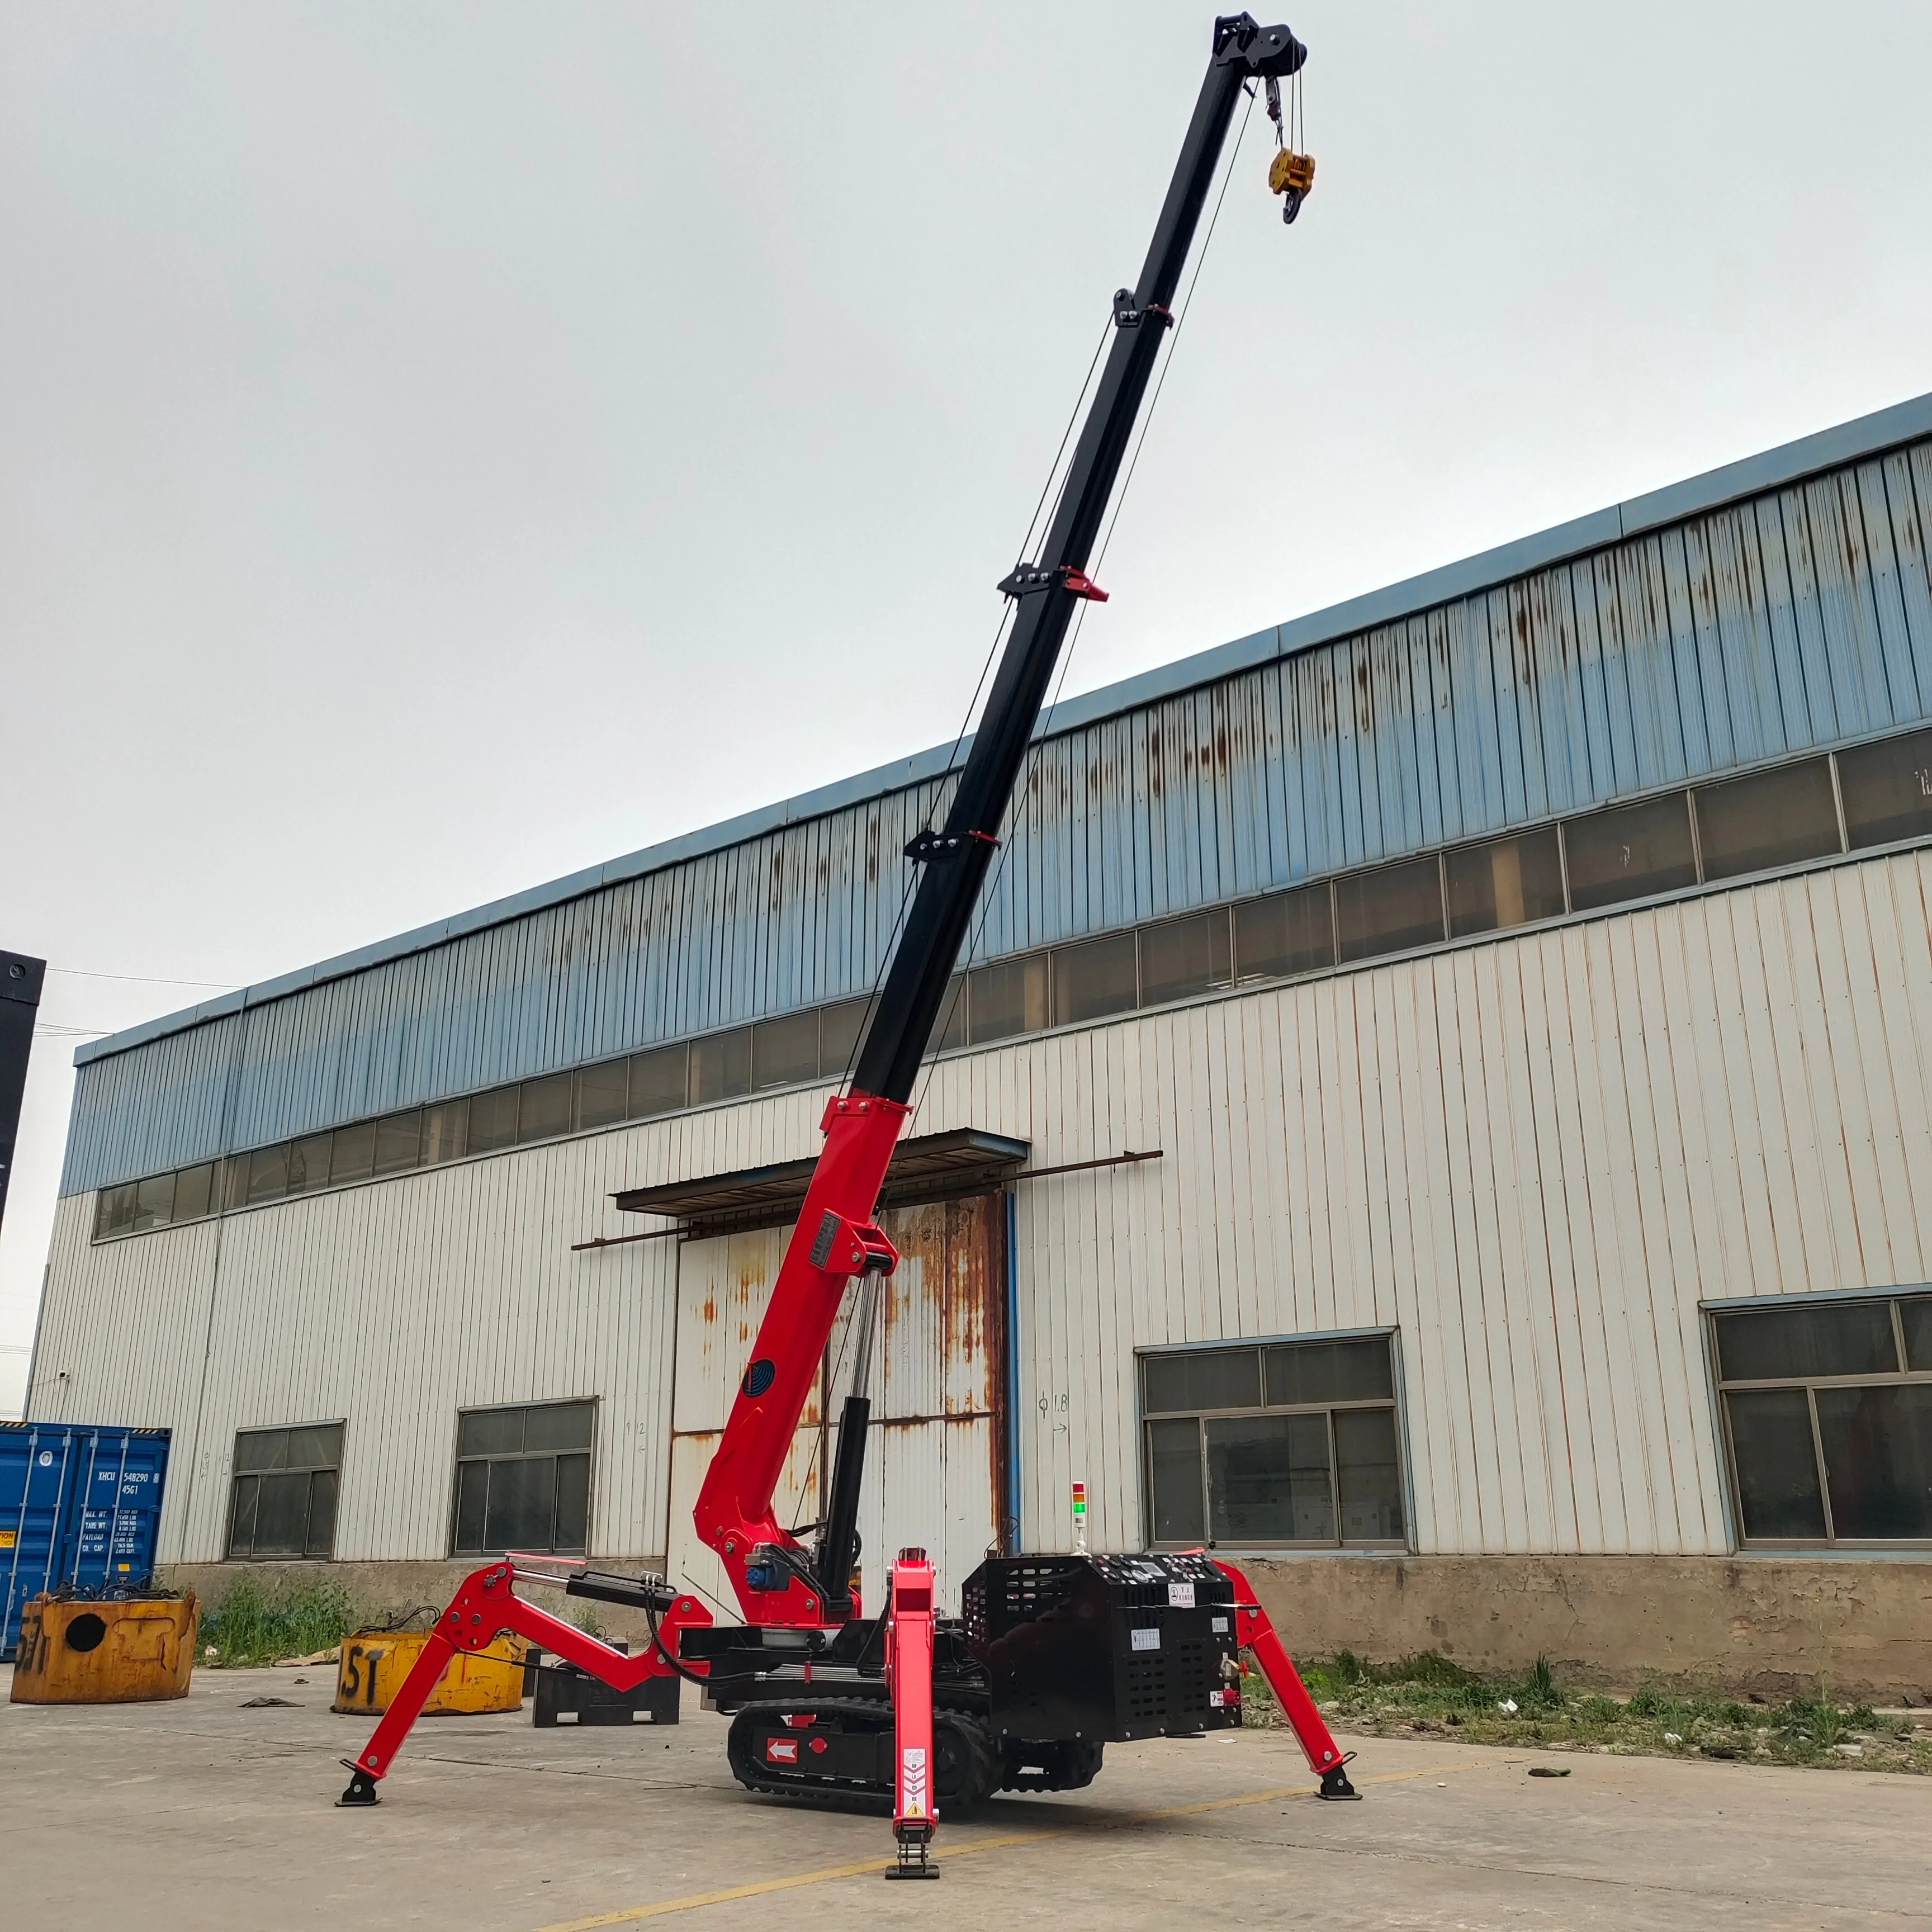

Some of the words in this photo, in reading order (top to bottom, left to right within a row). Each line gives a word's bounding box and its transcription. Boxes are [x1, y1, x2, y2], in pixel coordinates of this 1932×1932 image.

[98, 1471, 116, 1481] XHCU
[124, 1472, 148, 1482] 548290
[122, 1485, 138, 1494] 45G1
[341, 1646, 384, 1705] 5T
